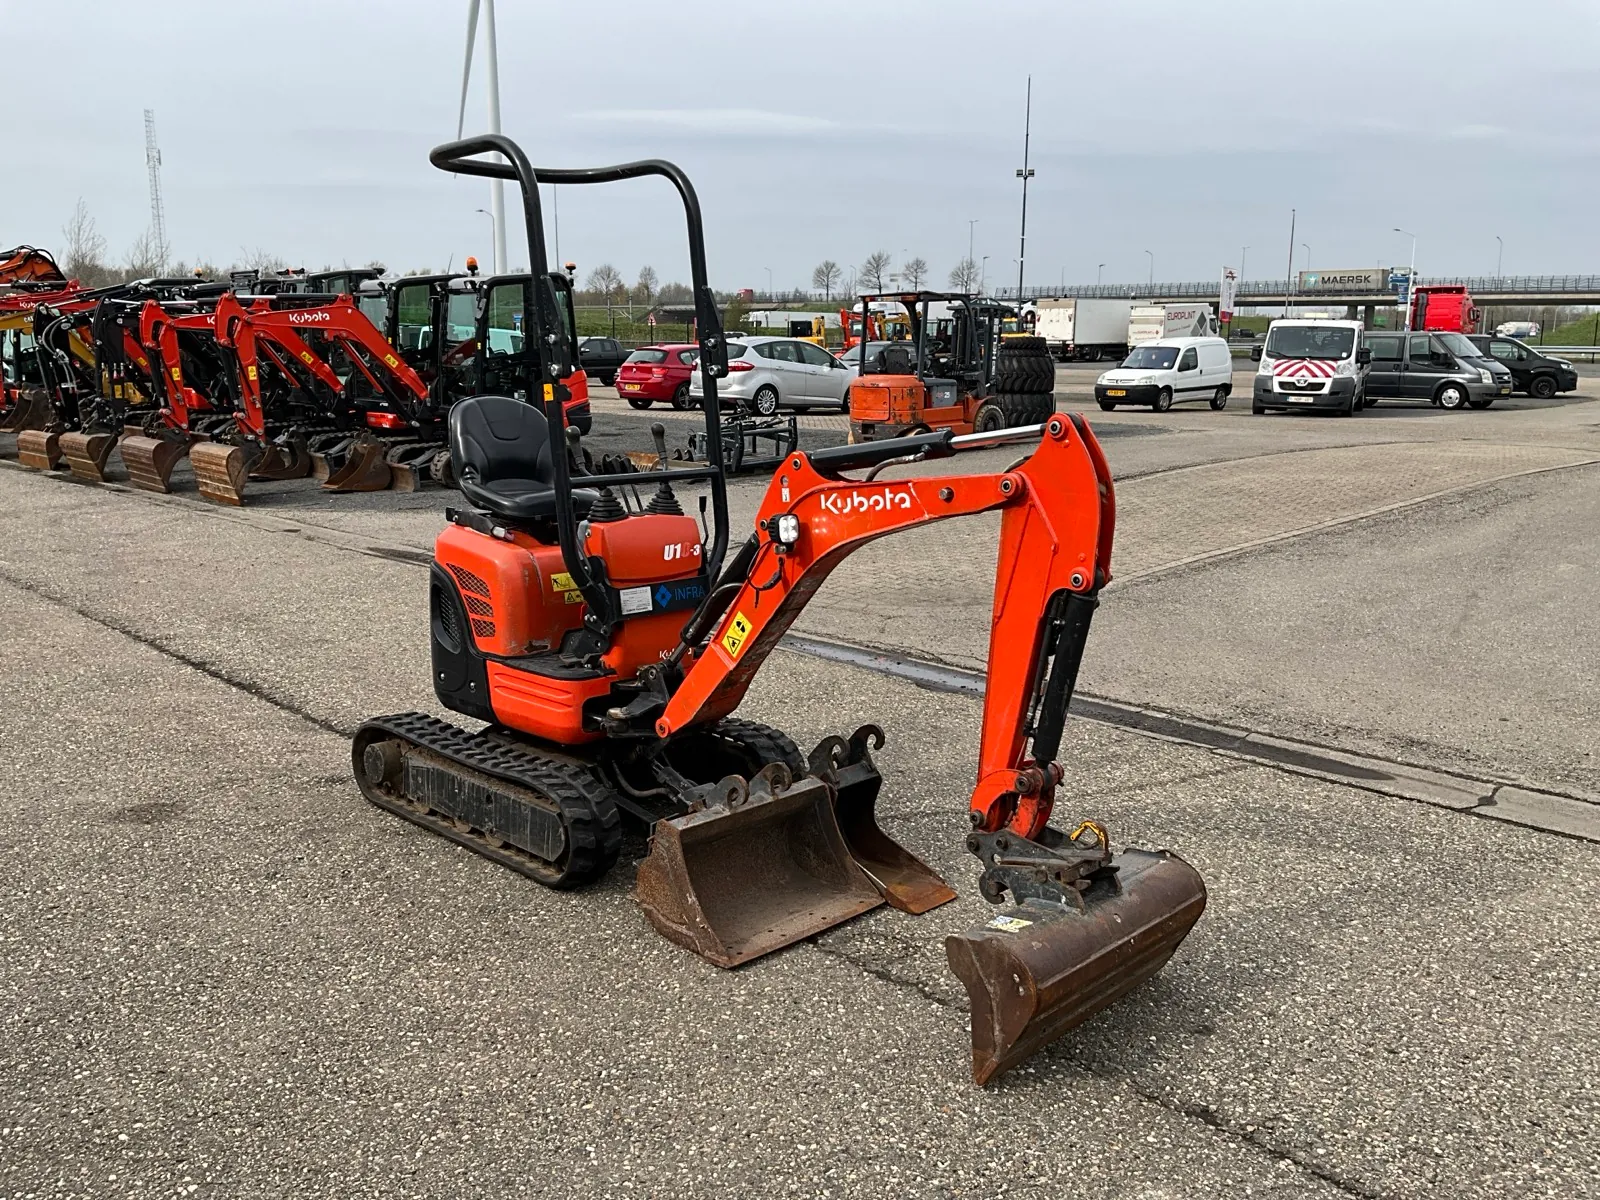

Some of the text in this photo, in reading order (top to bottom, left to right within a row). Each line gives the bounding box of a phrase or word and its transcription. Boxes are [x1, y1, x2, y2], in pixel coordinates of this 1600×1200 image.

[1321, 275, 1372, 284] MAERSK
[289, 311, 330, 323] Kubota
[820, 488, 911, 514] Kubota
[674, 586, 705, 601] INFRA
